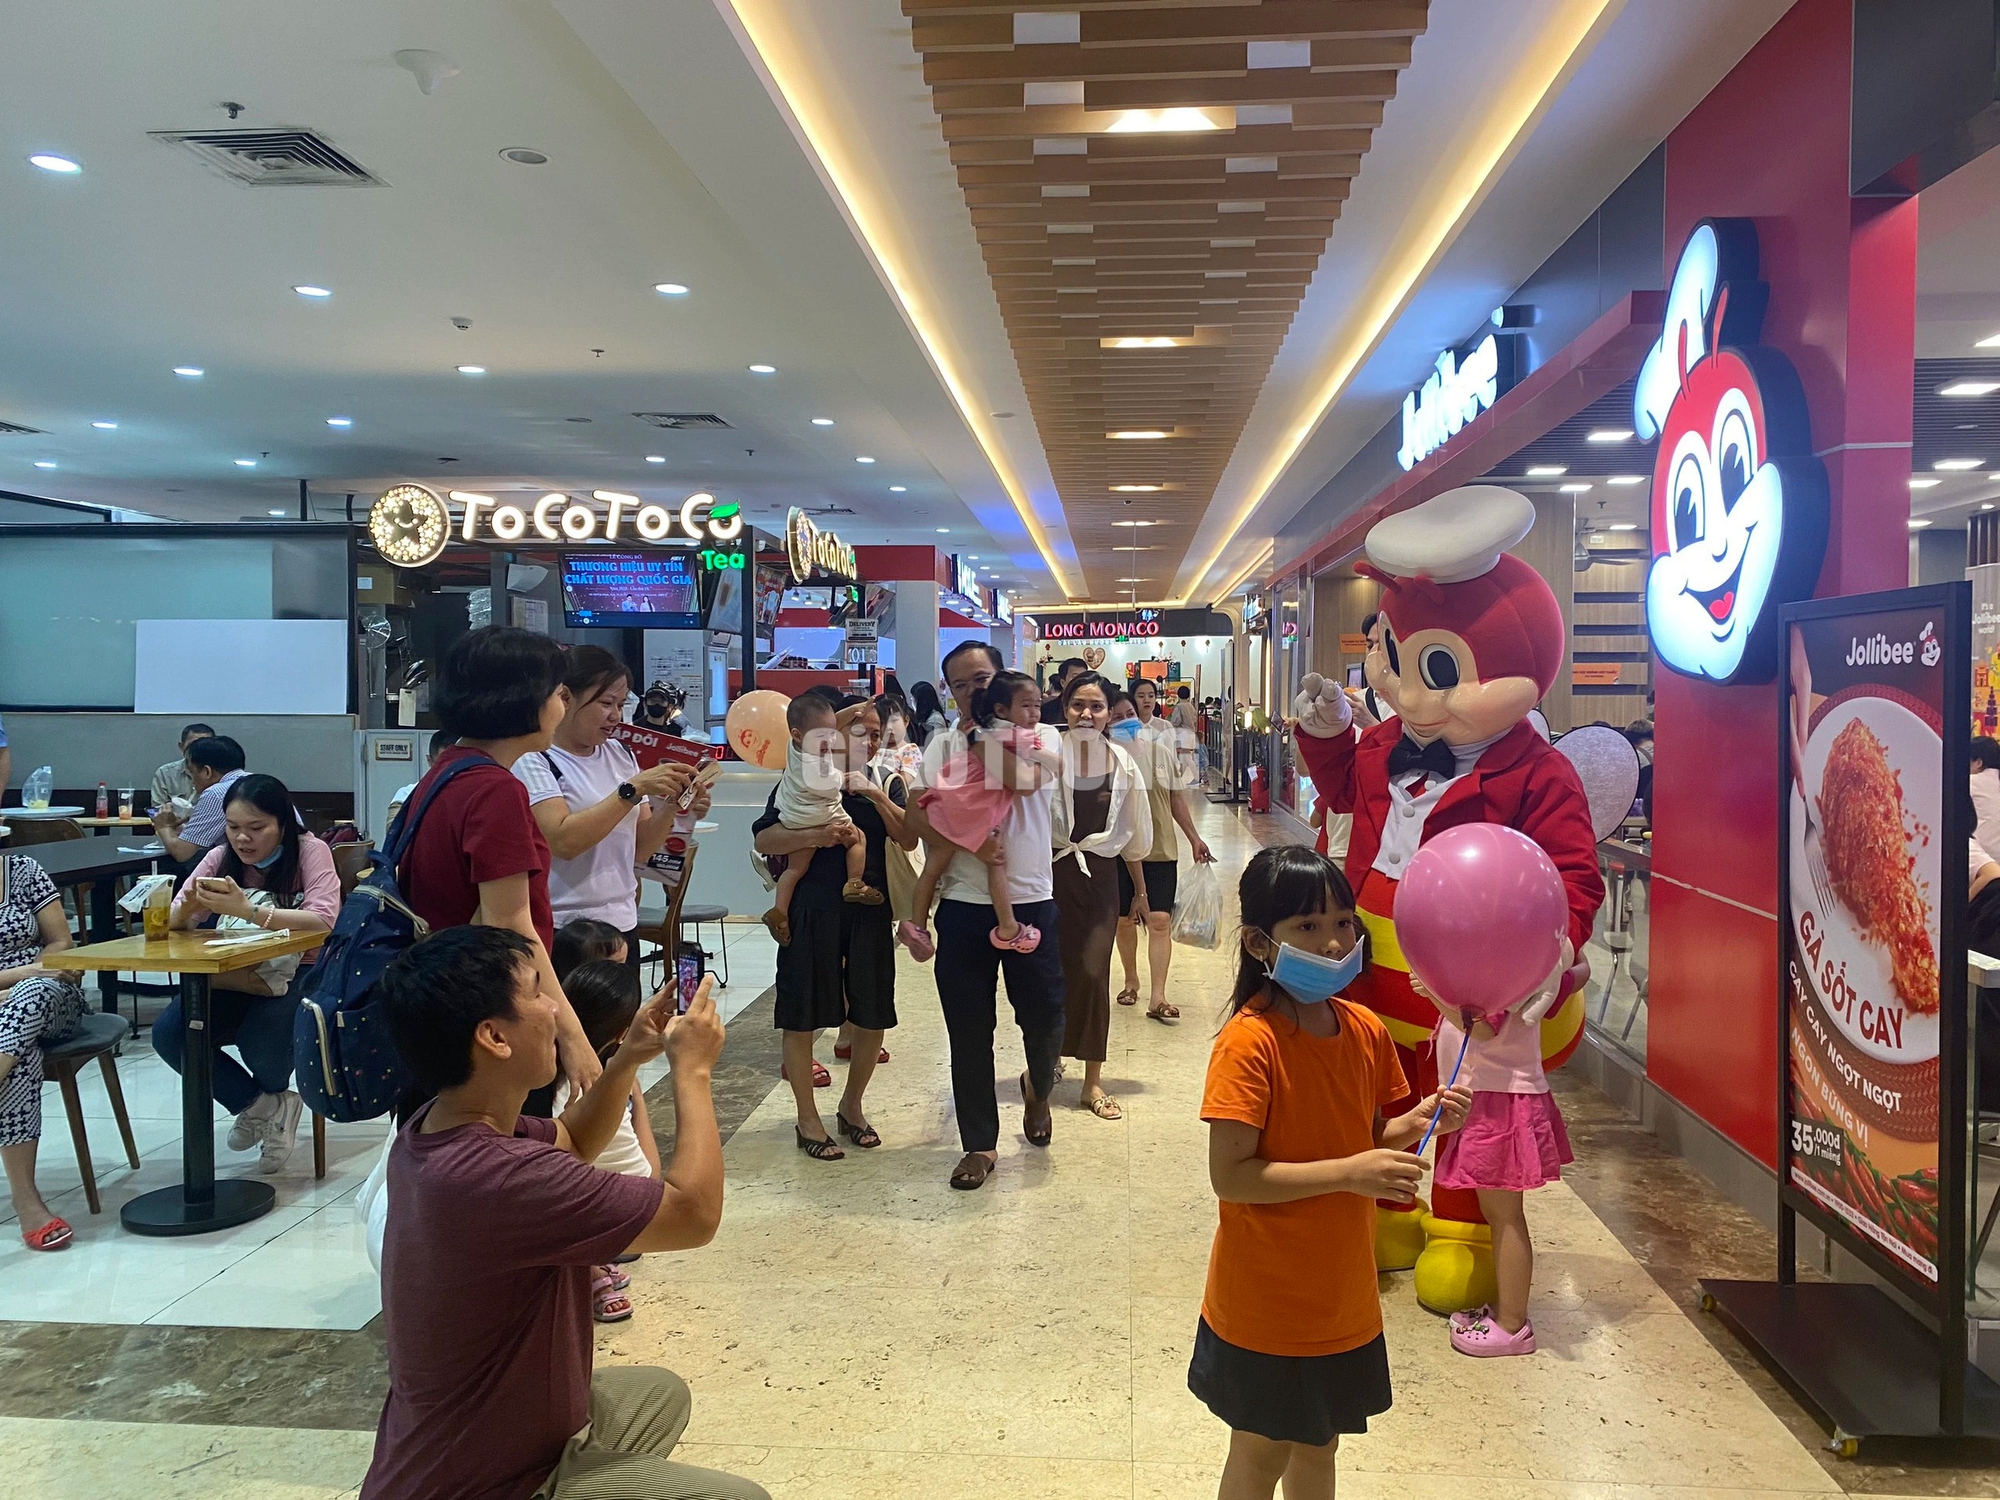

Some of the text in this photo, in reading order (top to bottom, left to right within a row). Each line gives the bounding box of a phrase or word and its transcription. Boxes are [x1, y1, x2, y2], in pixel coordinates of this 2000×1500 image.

[569, 561, 683, 574] THƯƠNG HIỆU UY TÍN
[701, 550, 746, 571] Tea
[565, 572, 692, 586] CHẤT LƯỢNG QUỐC GIA
[1045, 621, 1160, 638] LONG MONACO
[1845, 633, 1914, 667] Jollibee
[1800, 910, 1903, 1049] GÀ SỐT CAY
[1789, 960, 1902, 1114] CAY CAY NGỌT NGỌT
[1791, 1027, 1821, 1087] NGON
[1856, 1119, 1868, 1149] VỊ
